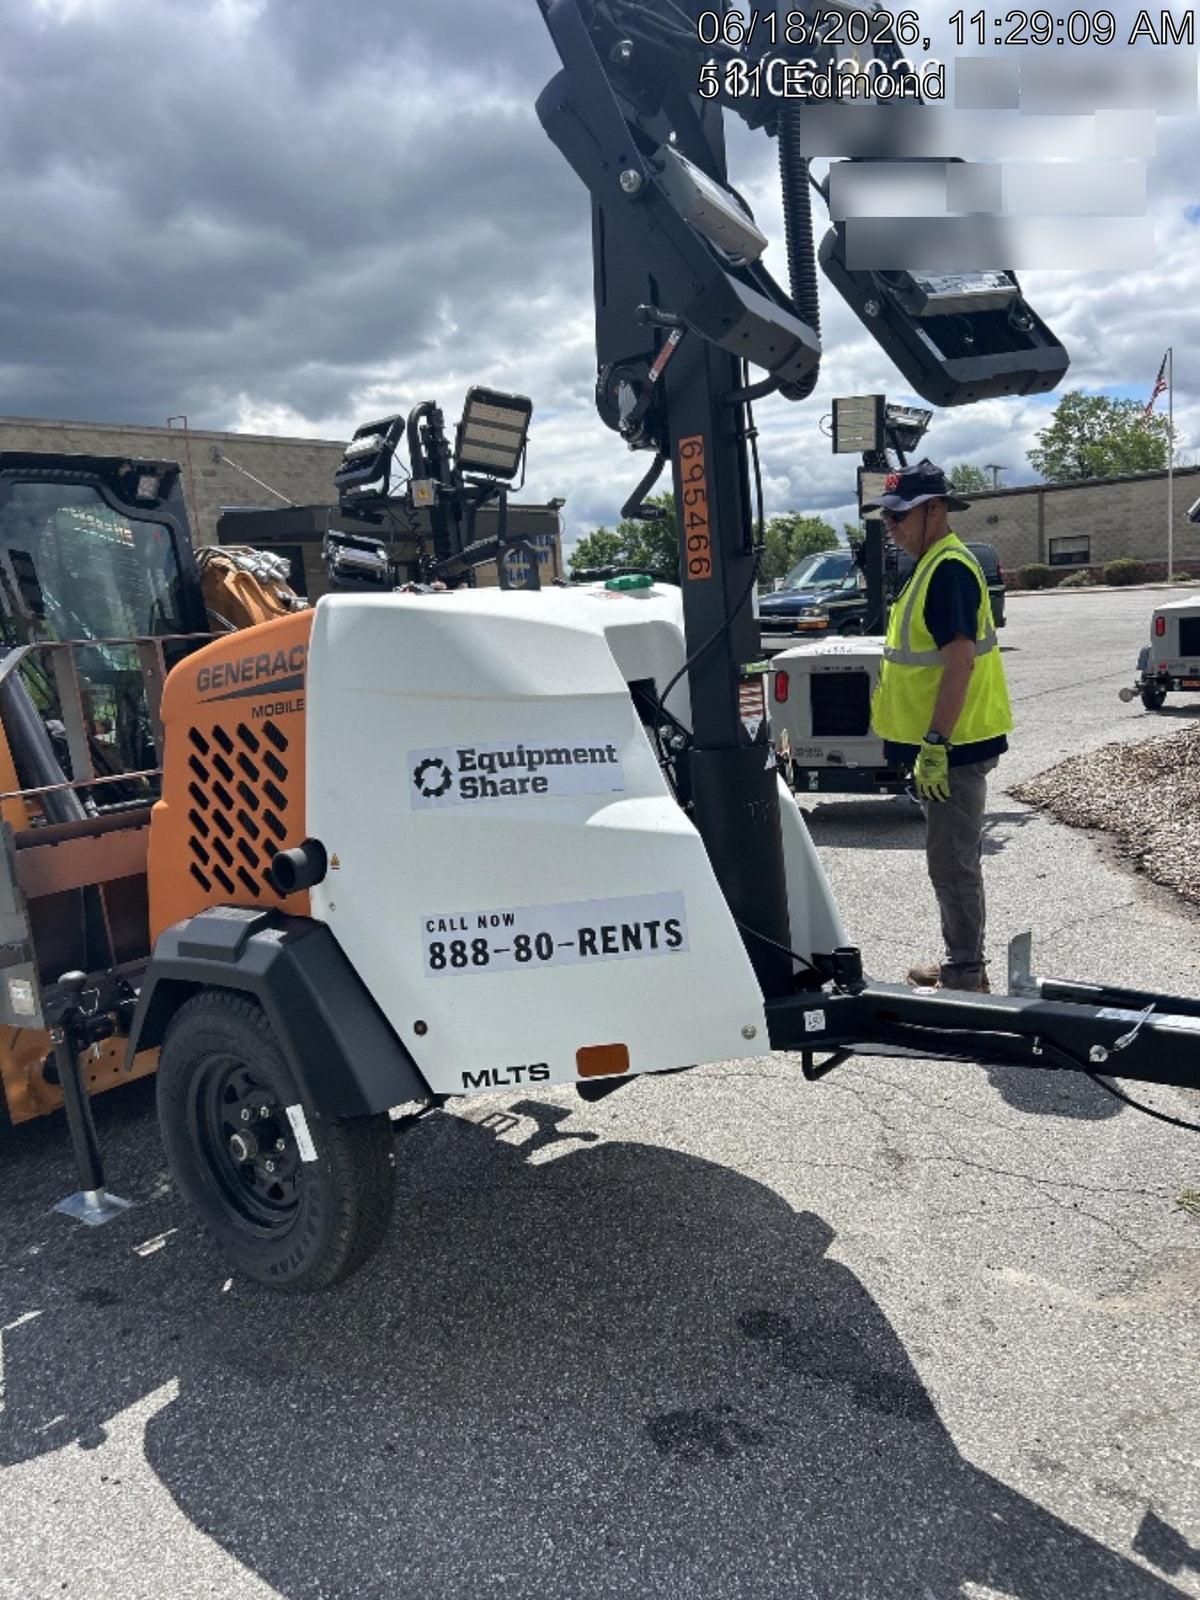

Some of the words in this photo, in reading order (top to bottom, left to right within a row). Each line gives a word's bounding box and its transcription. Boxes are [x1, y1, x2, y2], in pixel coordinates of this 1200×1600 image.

[680, 441, 711, 575] 695466
[197, 644, 306, 693] GENERAC
[252, 698, 305, 719] MOBILE
[456, 744, 618, 774] Equipment
[459, 775, 549, 799] Share
[426, 917, 468, 933] CALL
[477, 913, 515, 929] NOW
[429, 919, 683, 970] 888-80-RENTS
[462, 1063, 550, 1088] MLTS
